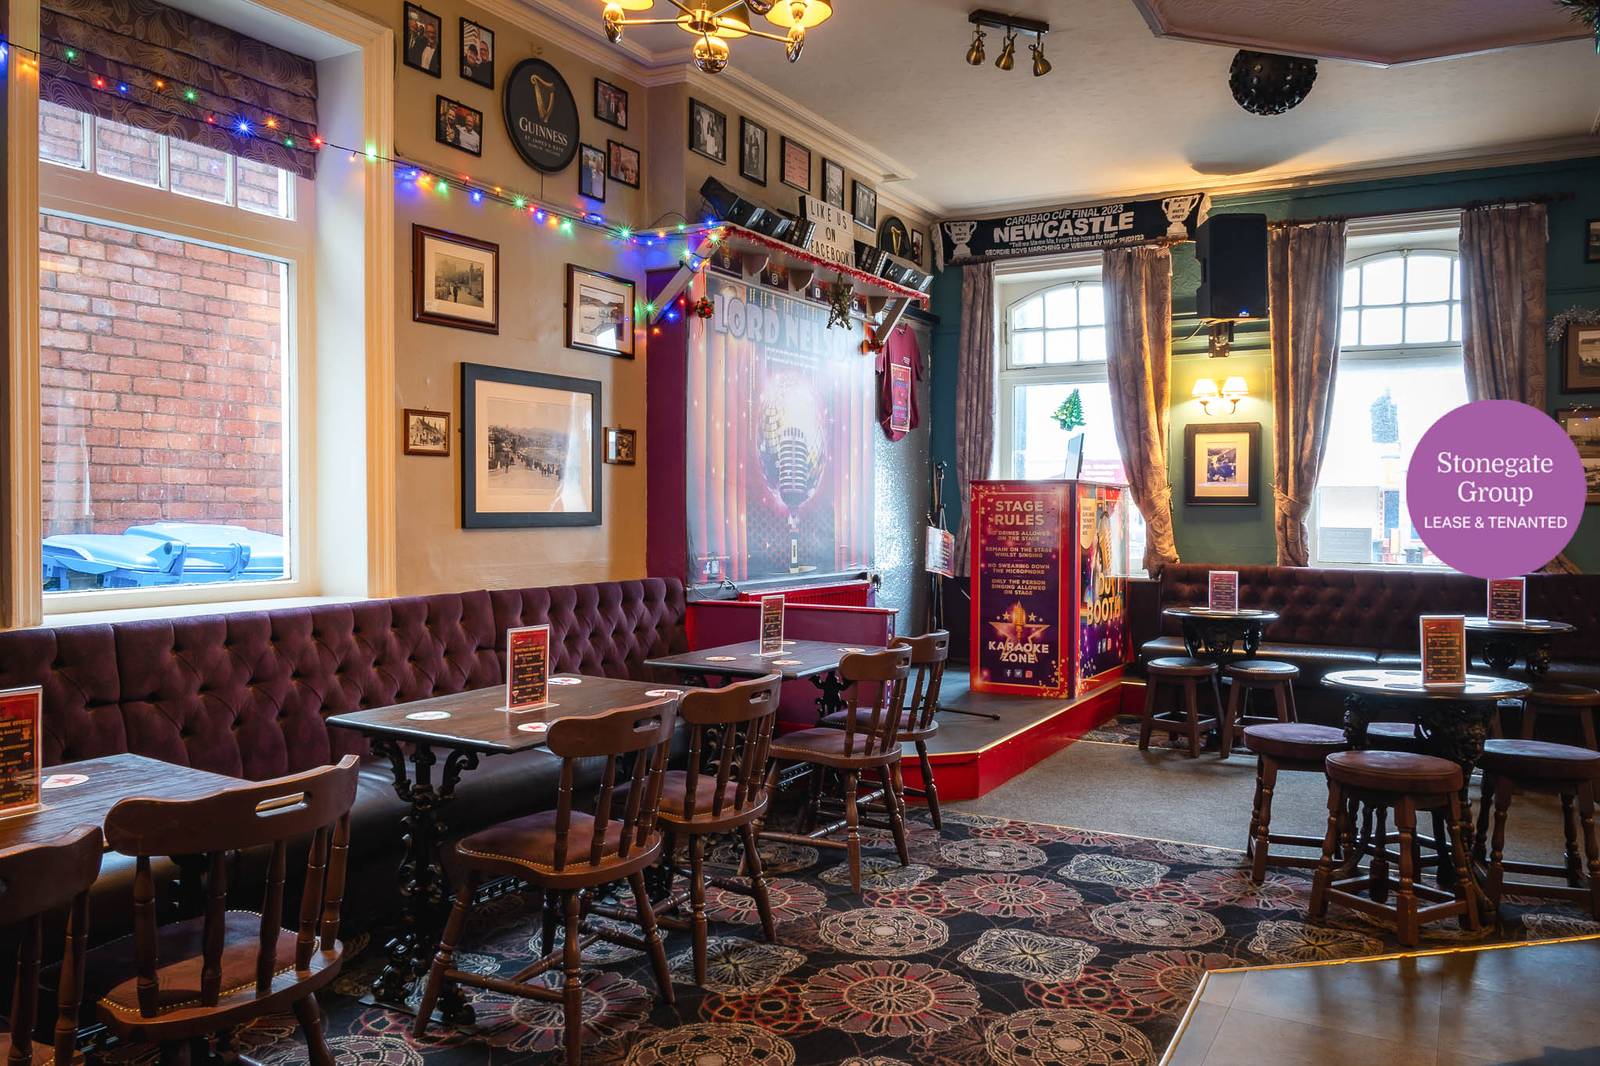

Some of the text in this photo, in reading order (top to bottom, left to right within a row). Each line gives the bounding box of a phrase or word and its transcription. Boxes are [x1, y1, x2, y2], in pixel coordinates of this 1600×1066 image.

[519, 117, 568, 146] GUINNESS
[810, 200, 847, 230] LIKE US
[1005, 204, 1124, 226] CARABAO CUP FINAL 2023
[825, 227, 836, 243] ON
[993, 211, 1135, 243] NEWCASTLE
[714, 294, 780, 345] LORD
[995, 500, 1044, 512] STAGE
[994, 514, 1045, 526] RULES
[1087, 596, 1121, 625] BOOTH
[988, 641, 1049, 653] KARAOKE
[1001, 653, 1035, 664] ZONE
